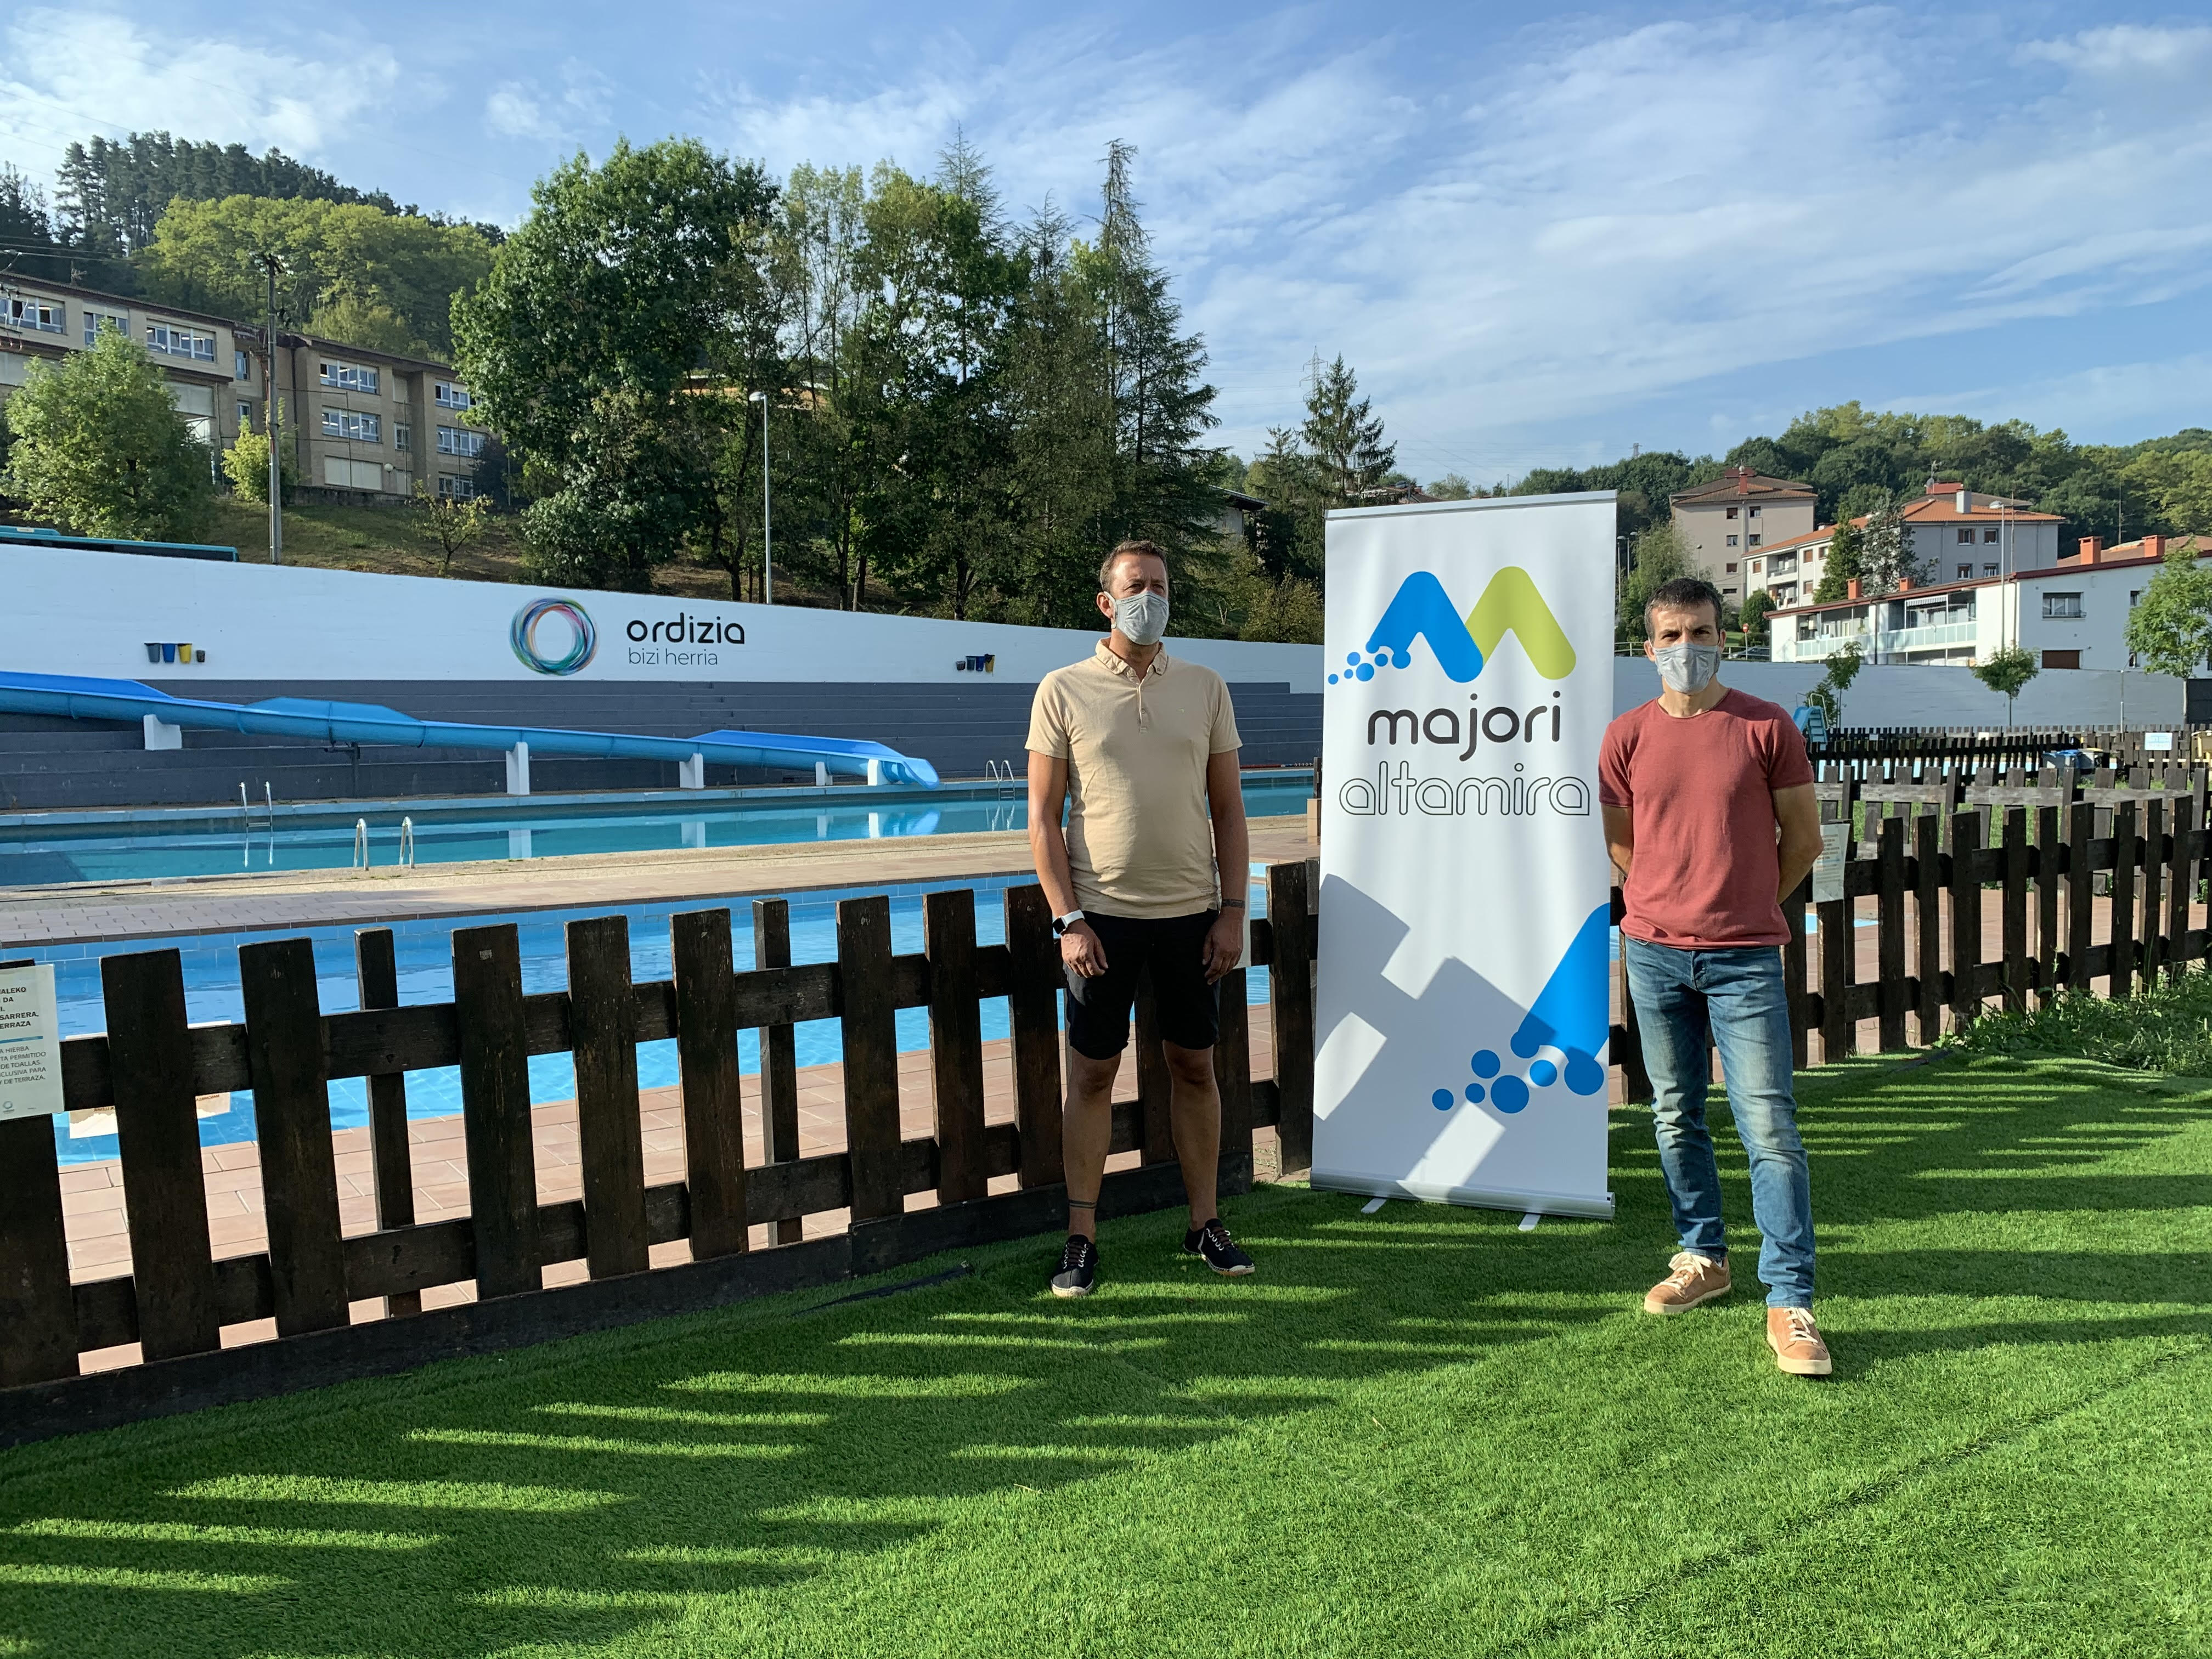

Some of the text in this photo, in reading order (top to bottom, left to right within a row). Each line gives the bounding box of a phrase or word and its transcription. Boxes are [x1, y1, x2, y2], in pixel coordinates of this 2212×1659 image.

[627, 612, 744, 644] ordizia
[629, 647, 718, 665] bizi herria
[1368, 691, 1560, 761] majori
[1339, 760, 1590, 816] altamira
[10, 1051, 46, 1060] PERMITIDO
